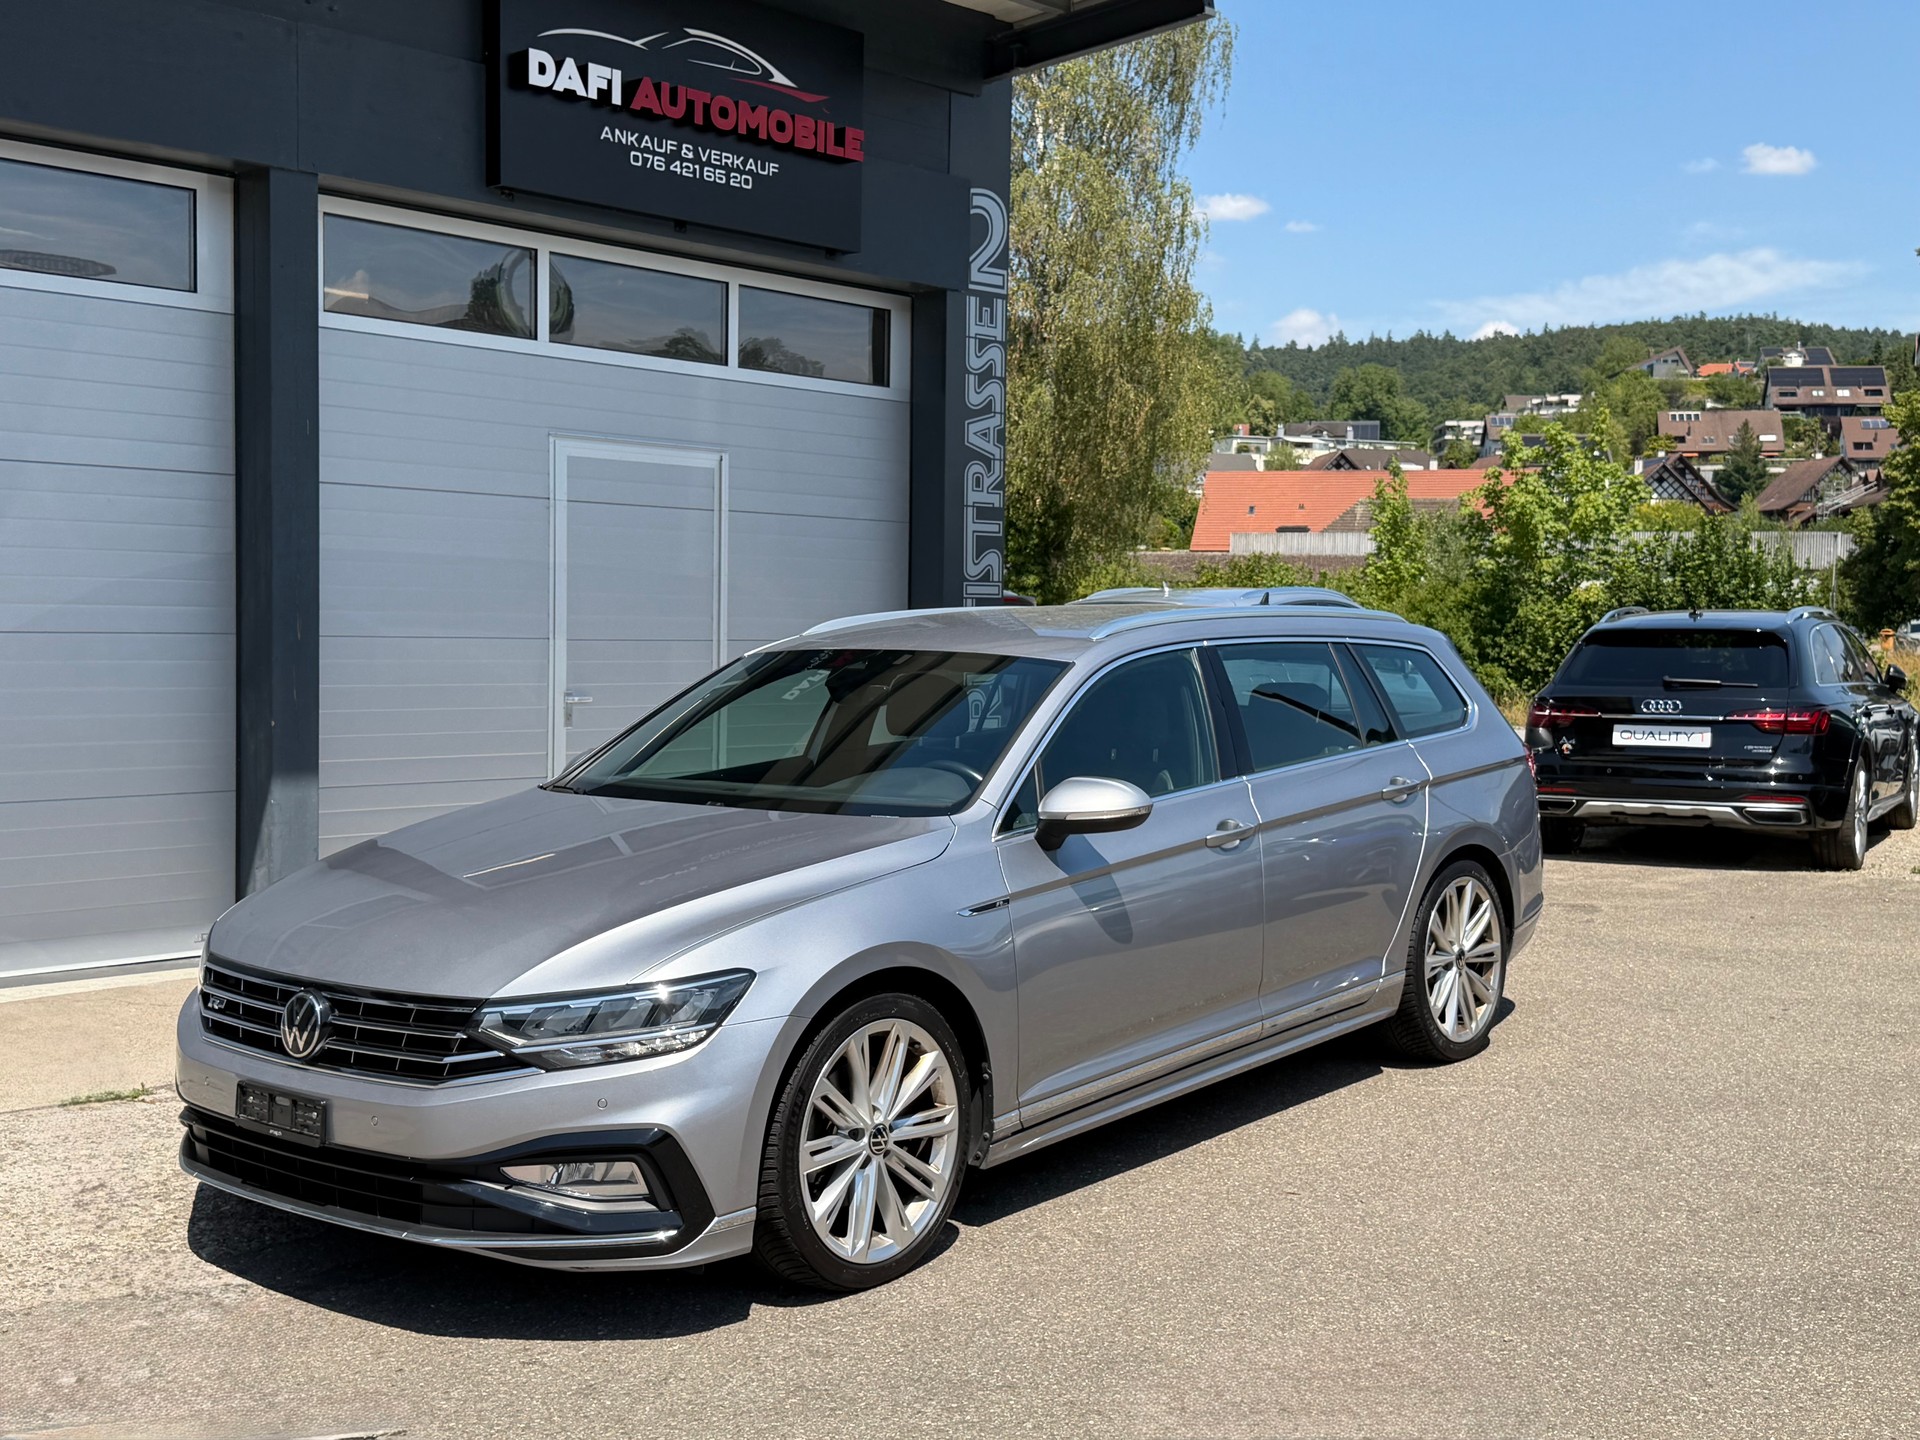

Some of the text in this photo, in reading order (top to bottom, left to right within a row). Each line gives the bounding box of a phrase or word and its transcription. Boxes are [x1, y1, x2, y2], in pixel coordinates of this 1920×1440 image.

[528, 47, 865, 163] DAFI AUTOMOBILE
[600, 126, 780, 176] ANKAUF & VERKAUF
[630, 151, 753, 190] 076 421 65 20
[963, 187, 1008, 607] ISTRASSE 2
[1619, 729, 1695, 742] QUALITY
